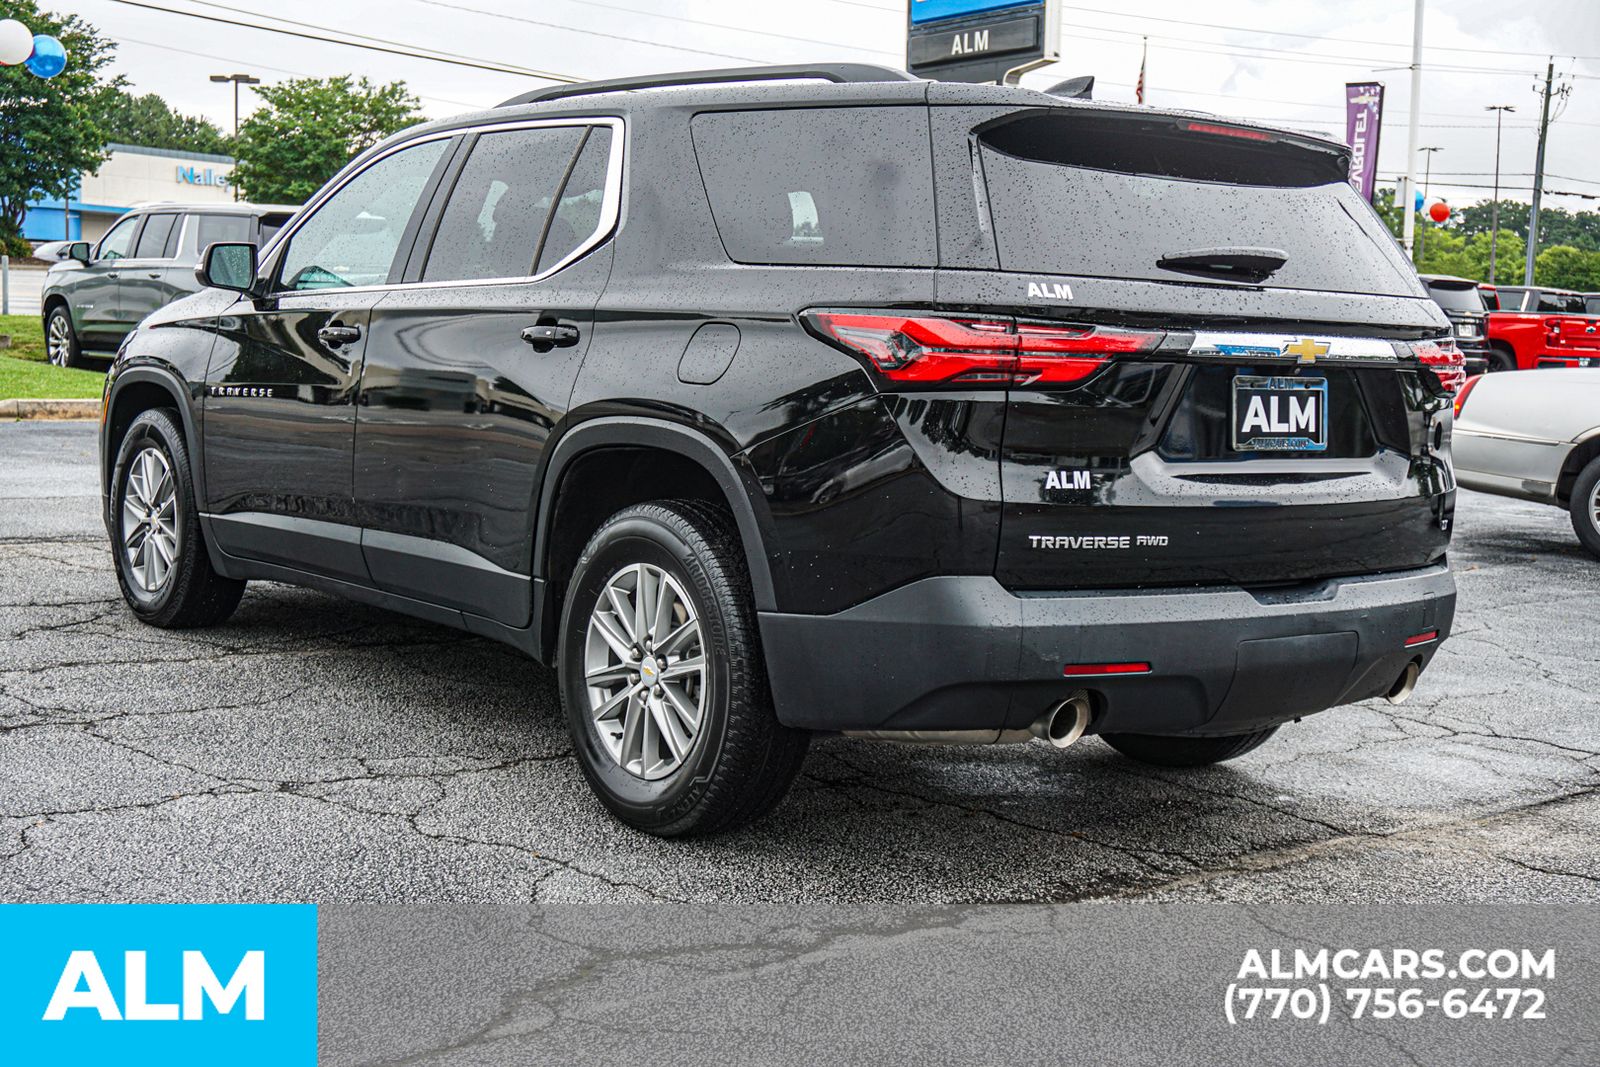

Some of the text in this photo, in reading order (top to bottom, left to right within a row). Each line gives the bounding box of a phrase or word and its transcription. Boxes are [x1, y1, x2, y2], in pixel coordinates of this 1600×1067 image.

[951, 30, 989, 55] ALM
[1028, 282, 1073, 299] ALM
[210, 386, 274, 398] TRAVERSE
[1269, 378, 1294, 390] ALM
[1241, 395, 1316, 433] ALM
[1045, 470, 1091, 490] ALM
[1028, 535, 1169, 549] TRAVERSE AWD
